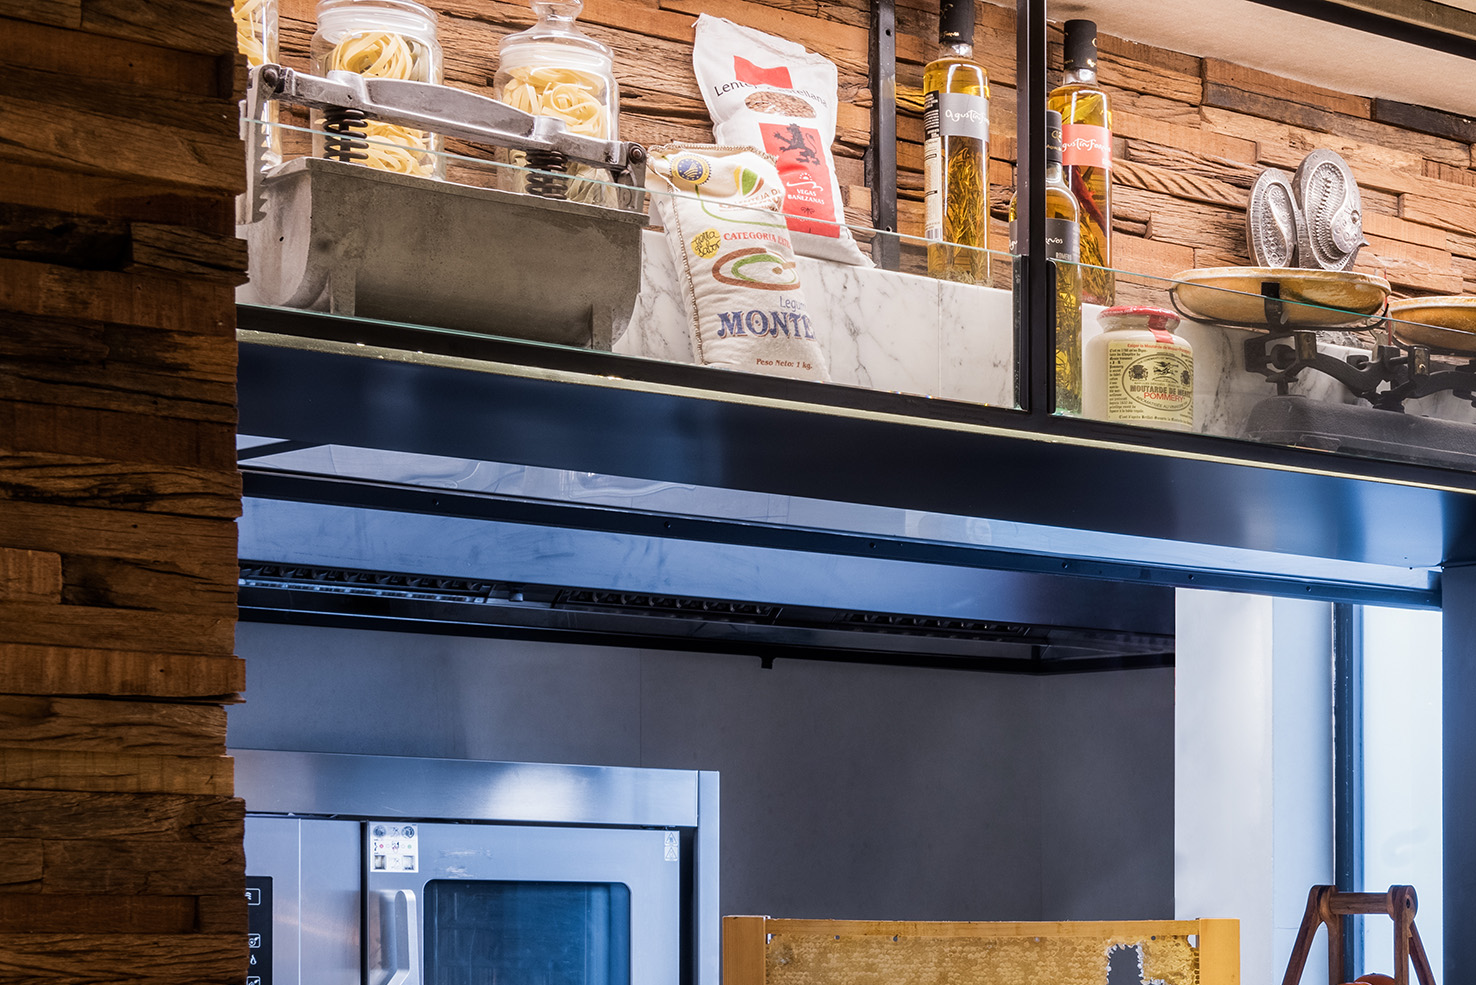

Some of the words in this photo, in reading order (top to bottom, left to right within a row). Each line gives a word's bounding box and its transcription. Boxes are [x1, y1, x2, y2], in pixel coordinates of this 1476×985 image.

[796, 188, 817, 197] VEGAS
[723, 231, 777, 243] CATEGORIA
[756, 358, 774, 366] Peso
[775, 359, 794, 368] Neto:
[1129, 385, 1168, 394] MOUTARDE
[1143, 391, 1184, 402] POMMERY
